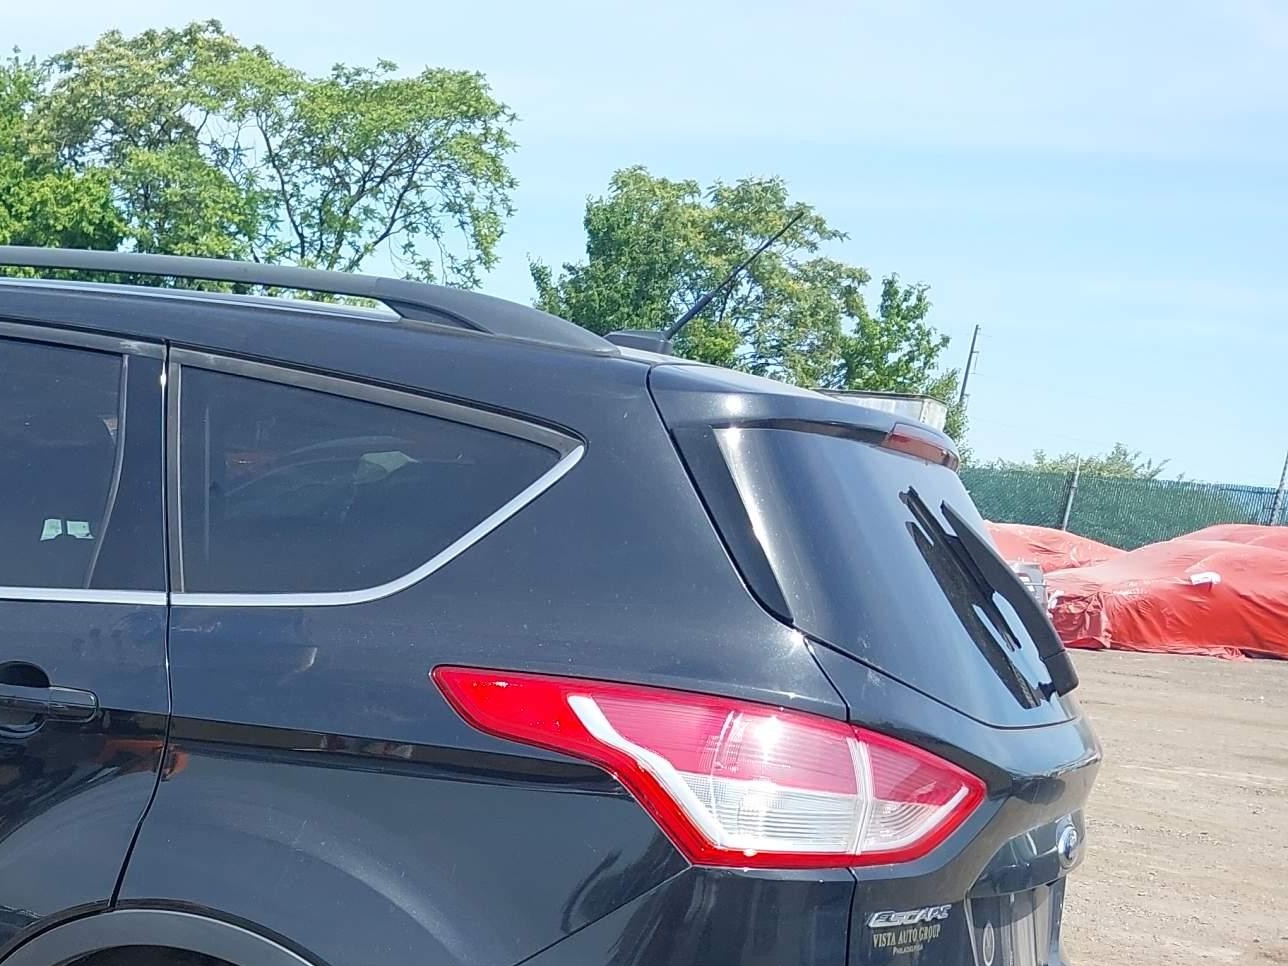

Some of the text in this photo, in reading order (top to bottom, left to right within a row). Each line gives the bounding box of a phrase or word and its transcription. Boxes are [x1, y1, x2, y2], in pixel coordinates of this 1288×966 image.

[868, 904, 952, 928] ESCAPE
[873, 924, 941, 948] VISTA AUTO GROUP
